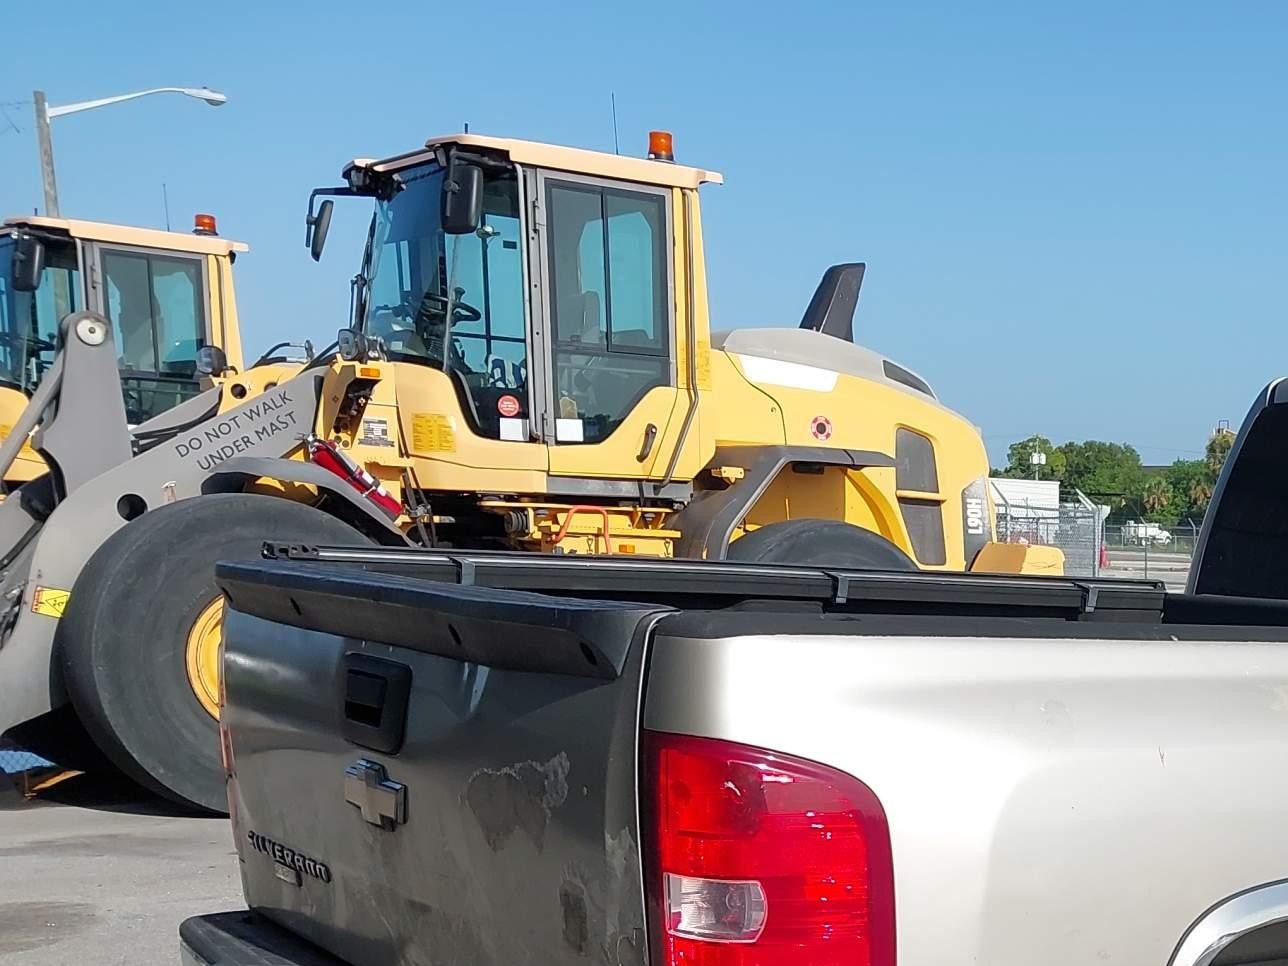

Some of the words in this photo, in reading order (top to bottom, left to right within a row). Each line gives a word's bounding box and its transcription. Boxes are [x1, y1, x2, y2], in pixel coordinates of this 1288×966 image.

[175, 437, 203, 458] DO
[204, 415, 241, 443] NOT
[243, 390, 294, 422] WALK
[196, 436, 256, 471] UNDER
[254, 411, 298, 441] MAST
[966, 498, 984, 534] L90H
[248, 830, 333, 884] SILVERADO
